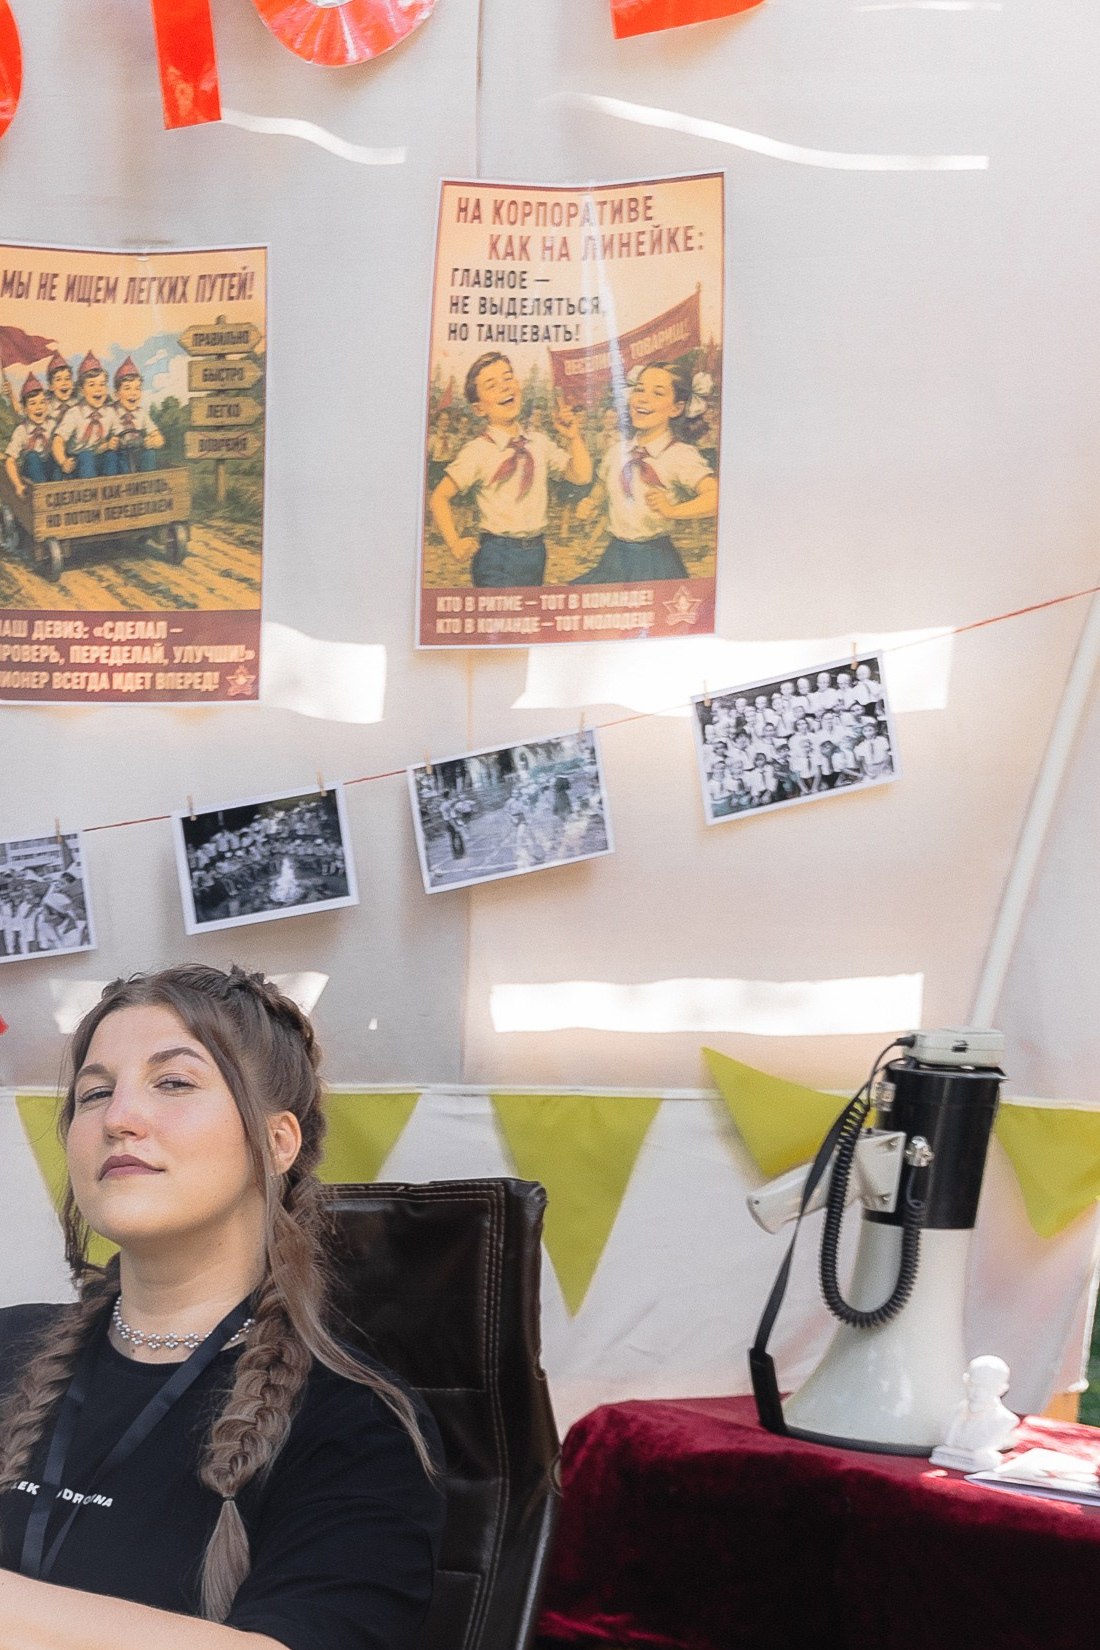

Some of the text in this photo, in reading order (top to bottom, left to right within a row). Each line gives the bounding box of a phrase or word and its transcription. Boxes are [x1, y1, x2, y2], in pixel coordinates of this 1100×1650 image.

[456, 195, 654, 228] НА КОРПОРАТИВЕ
[488, 223, 704, 262] КАК НА ЛИНЕЙКЕ:
[0, 266, 255, 307] МЫ НЕ ИЩЕМ ЛЕГКИХ ПУТЕЙ!
[450, 267, 528, 290] ГЛАВНОЕ
[449, 295, 470, 315] НЕ
[448, 322, 581, 345] НО ТАНЦЕВАТЬ!
[436, 596, 462, 612] КТО
[464, 596, 476, 612] В
[540, 594, 567, 611] ТОТ
[568, 593, 580, 610] В
[31, 619, 90, 641] ДЕВИЗ:
[92, 620, 168, 642] «СДЕЛАЛ
[436, 618, 461, 634] КТО
[463, 618, 476, 634] В
[554, 614, 581, 631] ТОТ
[69, 642, 169, 667] ПЕРЕДЕЛАЙ,
[52, 670, 111, 693] ВСЕГДА
[112, 671, 154, 693] ИДЕТ
[155, 671, 220, 692] ВПЕРЕД!
